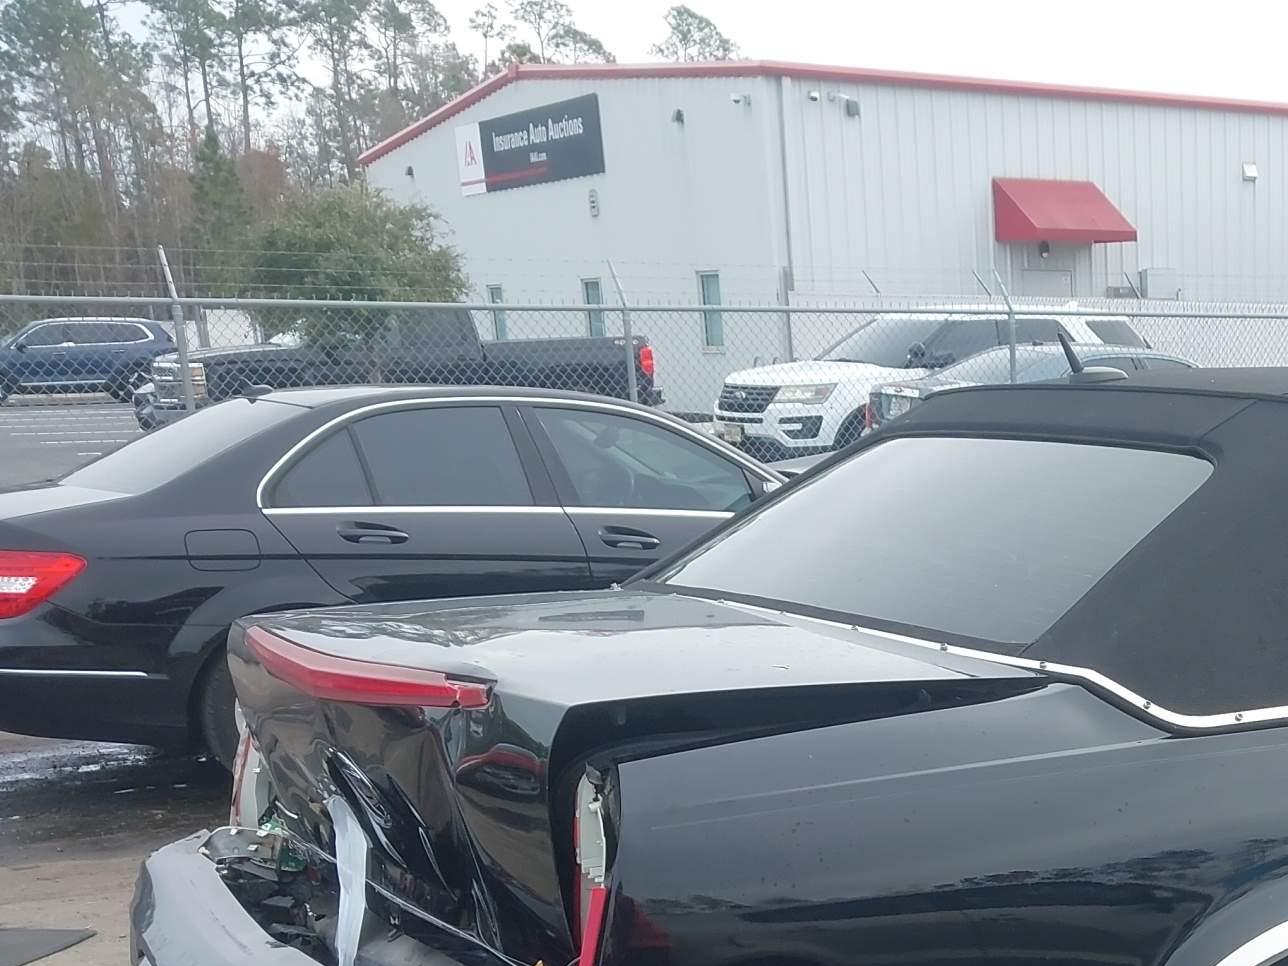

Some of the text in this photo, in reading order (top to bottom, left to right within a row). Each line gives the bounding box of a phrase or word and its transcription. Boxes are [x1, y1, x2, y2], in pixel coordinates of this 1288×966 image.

[492, 114, 584, 152] Insurance Auto Auctions
